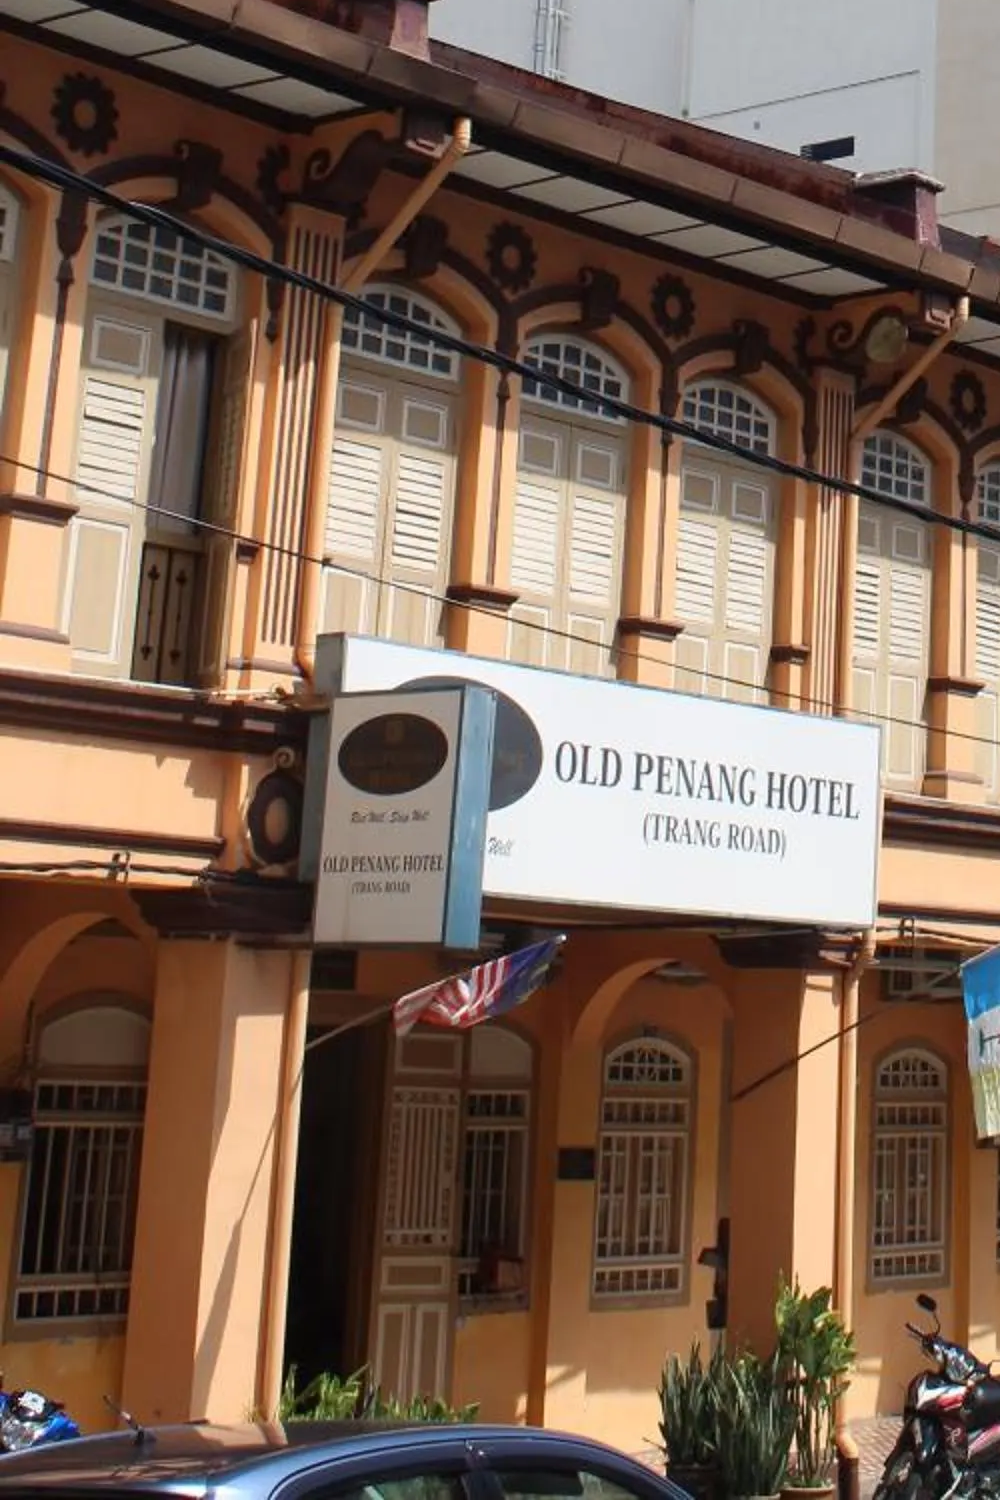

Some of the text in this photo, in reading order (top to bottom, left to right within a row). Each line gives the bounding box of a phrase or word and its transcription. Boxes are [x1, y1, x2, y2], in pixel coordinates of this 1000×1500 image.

[555, 740, 861, 820] OLD PENANG HOTEL
[643, 812, 787, 862] (TRANG ROAD)
[323, 853, 444, 873] OLD PENANG HOTEL
